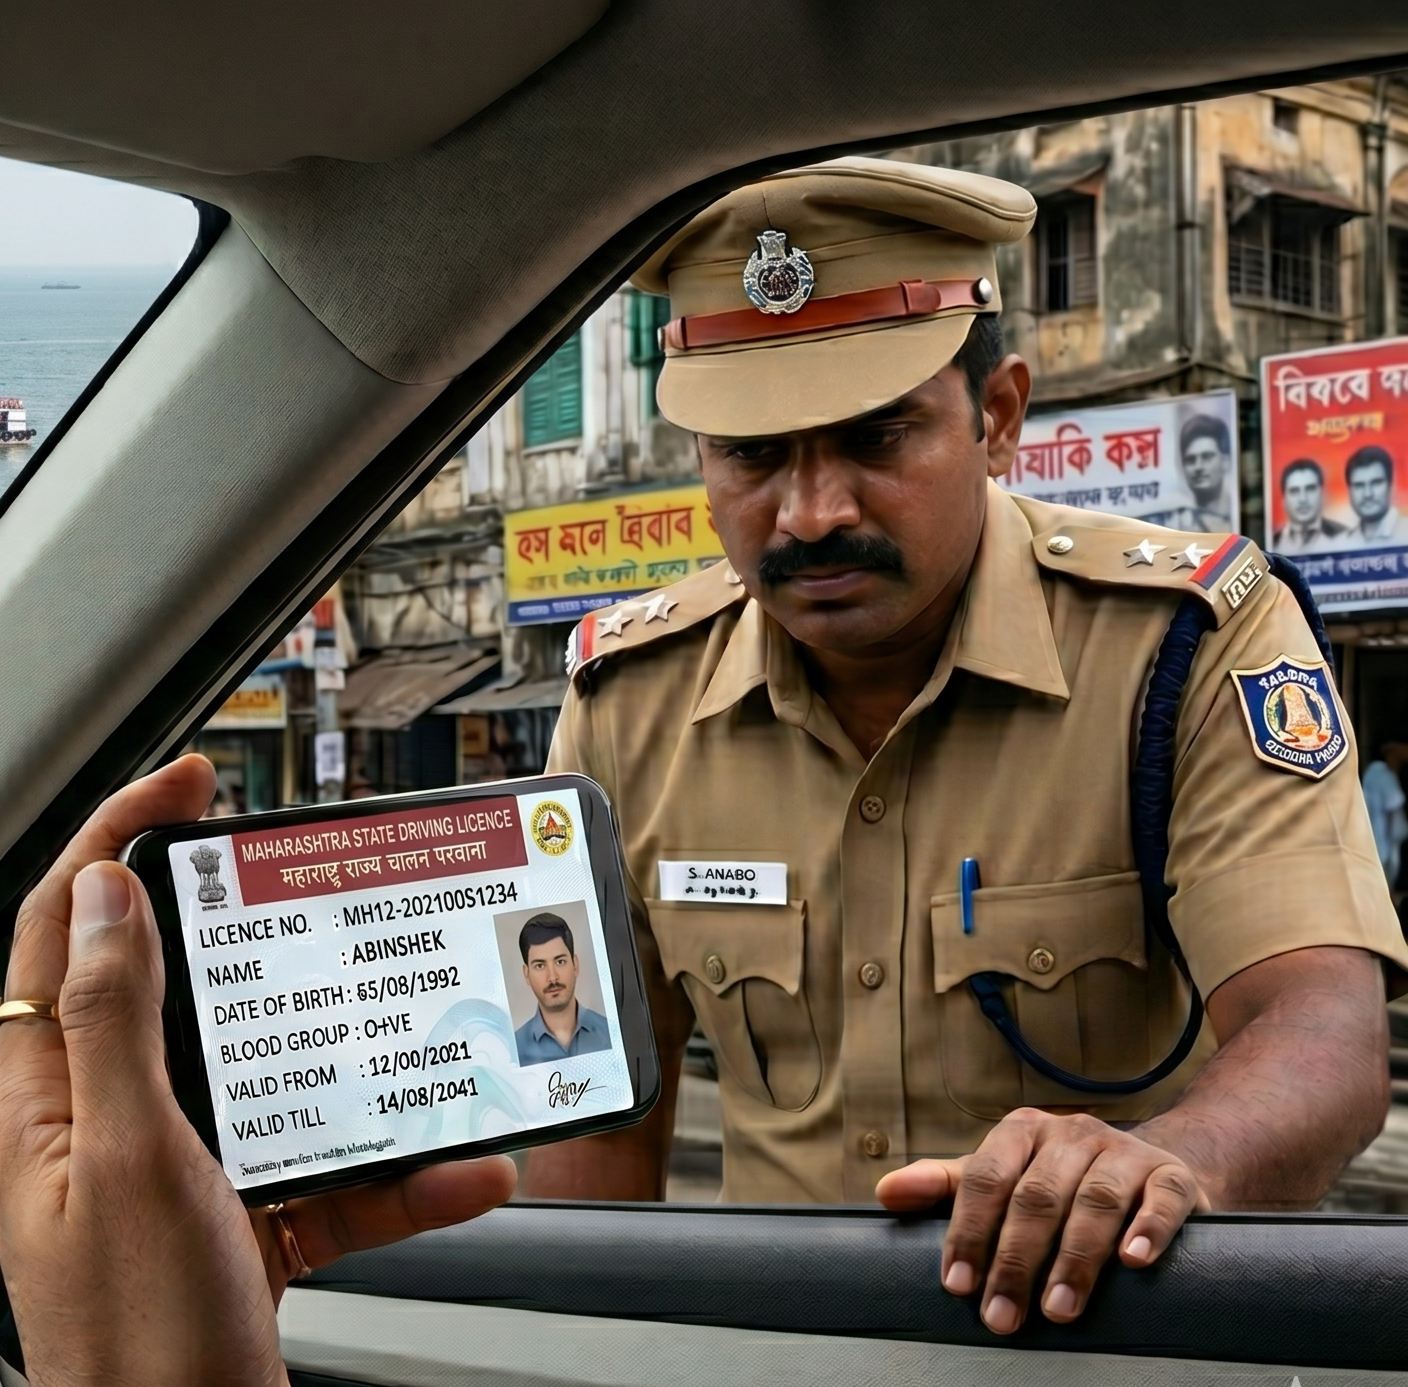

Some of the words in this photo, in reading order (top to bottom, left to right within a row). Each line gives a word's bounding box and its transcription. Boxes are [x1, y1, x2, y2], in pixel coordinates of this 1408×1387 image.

[241, 831, 351, 863] MAHARASHTRA
[353, 825, 394, 848] STATE
[398, 817, 454, 841] DRIVING
[456, 809, 513, 834] LICENCE
[343, 856, 382, 878] राज्य
[386, 848, 431, 873] चालन
[433, 841, 487, 866] परवाना
[705, 868, 756, 881] ANABO
[199, 918, 275, 948] LICENCE
[279, 913, 312, 936] NO.
[206, 960, 264, 988] NAME
[352, 929, 446, 965] ABINSHEK
[214, 1000, 260, 1026] DATE
[264, 995, 287, 1017] OF
[220, 1035, 282, 1064] BLOOD
[287, 1023, 349, 1050] GROUP
[226, 1076, 279, 1102] VALID
[283, 1064, 337, 1092] FROM
[369, 1041, 472, 1077] 12/00/2021
[231, 1115, 285, 1141] VALID
[287, 1106, 326, 1130] TILL
[376, 1077, 479, 1115] 14/08/2041
